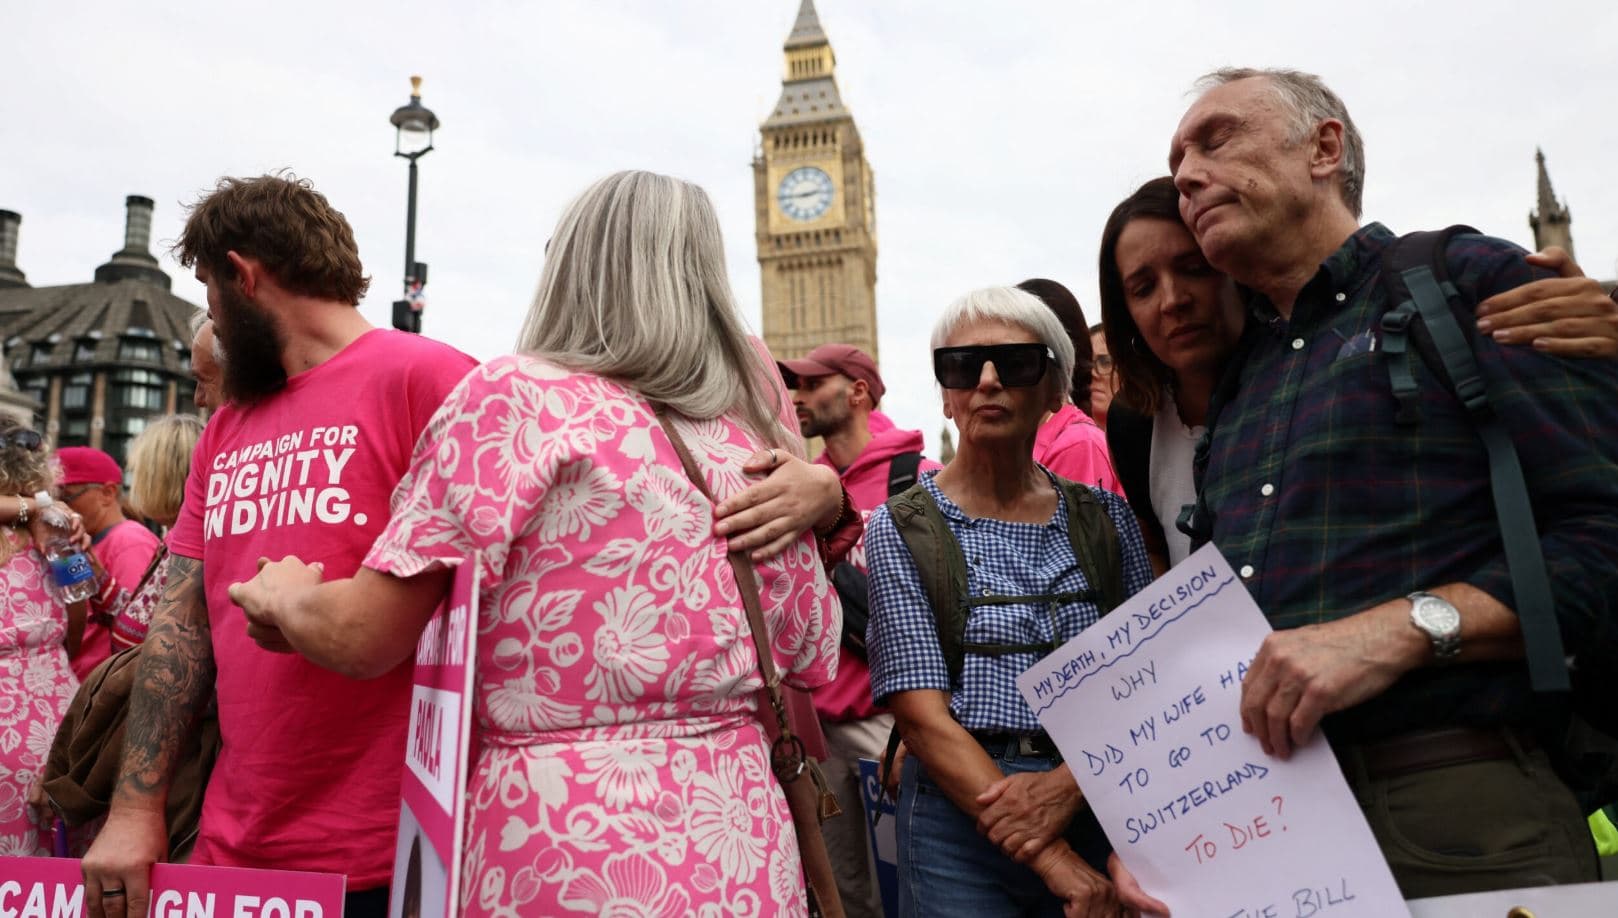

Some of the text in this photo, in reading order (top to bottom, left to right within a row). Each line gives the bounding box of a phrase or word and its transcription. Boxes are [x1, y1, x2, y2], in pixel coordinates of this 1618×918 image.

[206, 448, 356, 508] DIGNITY
[213, 425, 359, 471] CAMPAIGN FOR
[231, 487, 368, 535] DYING.
[1033, 677, 1054, 700] MY
[1107, 621, 1132, 650] MY
[1132, 565, 1217, 631] DECISION
[1111, 660, 1158, 701] WHY
[412, 698, 444, 783] PAOLA
[1082, 659, 1253, 777] DID MY WIFE HA
[1119, 723, 1231, 795] TO GO TO
[1126, 762, 1269, 844] SWITZERLAND
[1223, 795, 1288, 850] DIE?
[1292, 877, 1356, 918] BILL
